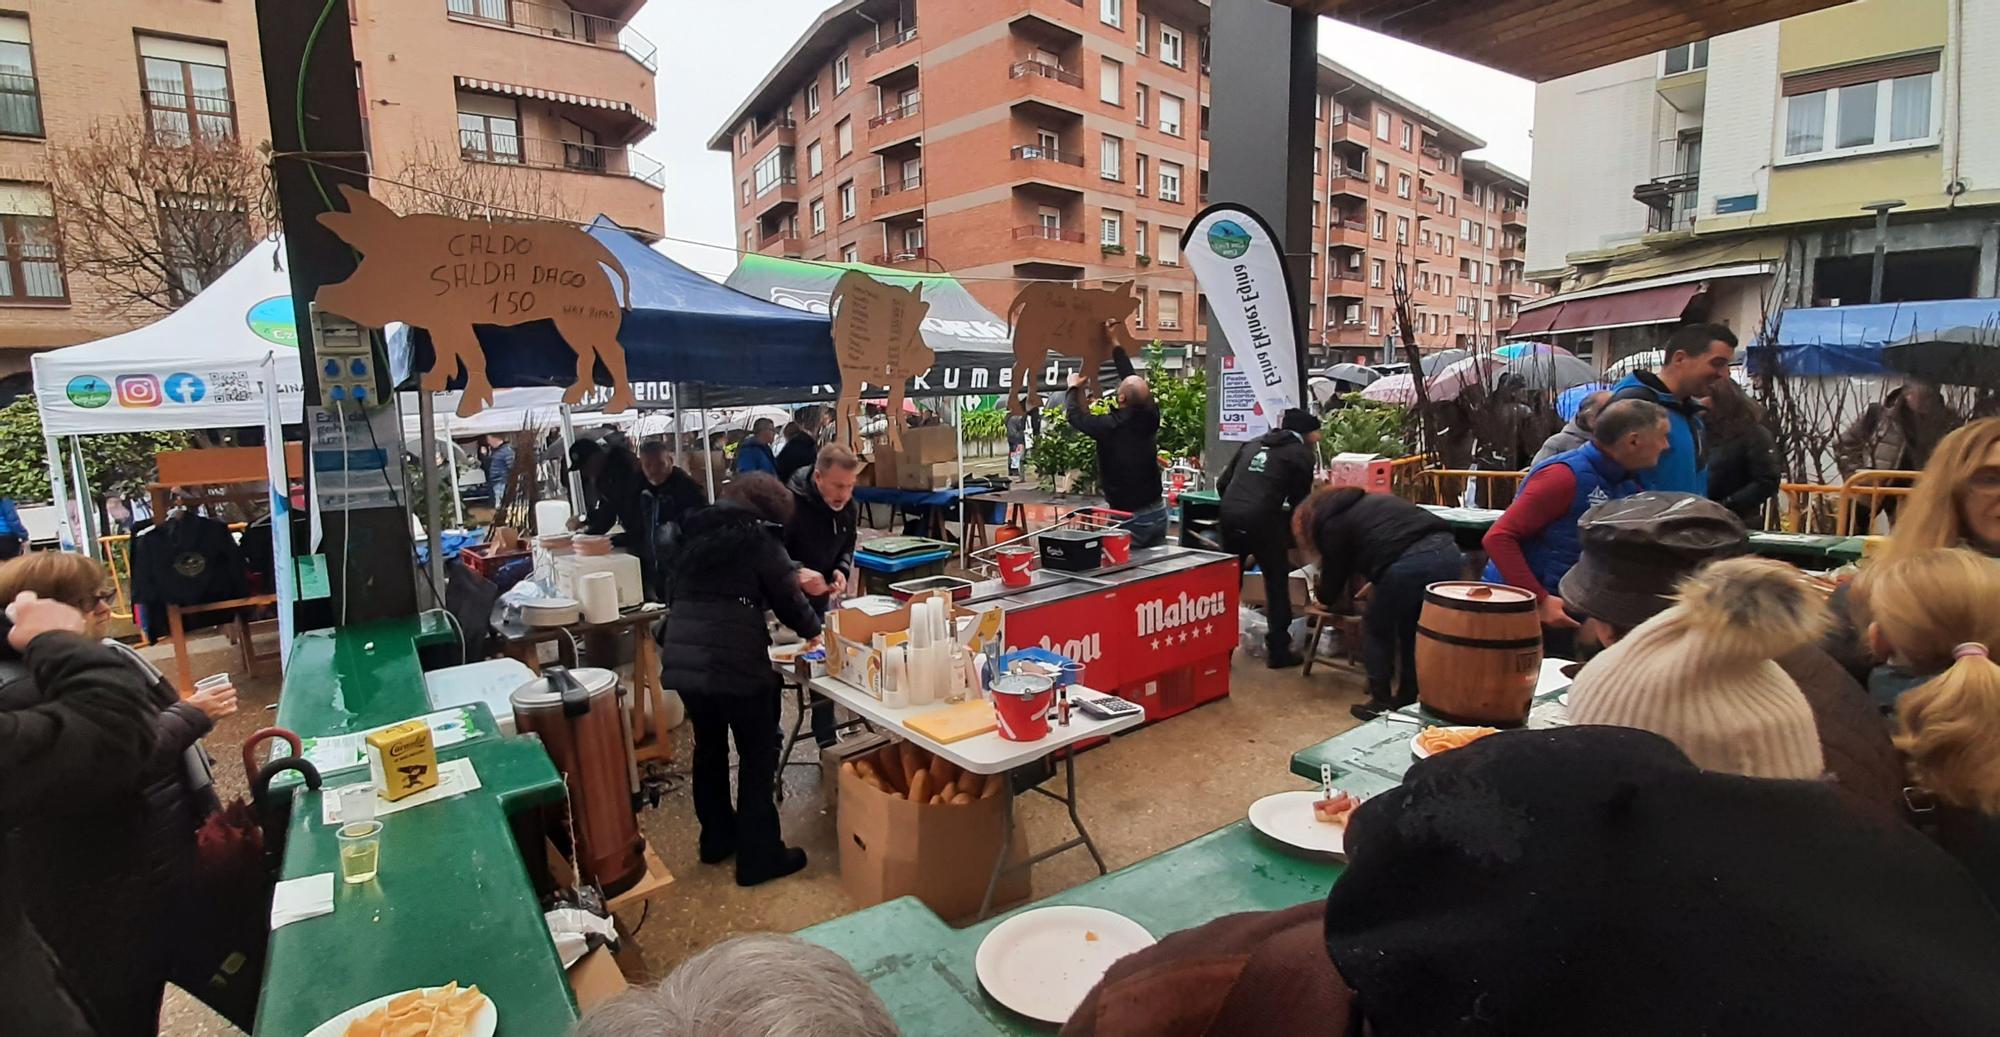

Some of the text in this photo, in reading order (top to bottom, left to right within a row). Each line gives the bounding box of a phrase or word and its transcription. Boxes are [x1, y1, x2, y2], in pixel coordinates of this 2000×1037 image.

[448, 234, 533, 257] CALDO
[430, 260, 516, 296] SALDA
[1223, 413, 1245, 422] U31
[1135, 590, 1226, 638] Mahou
